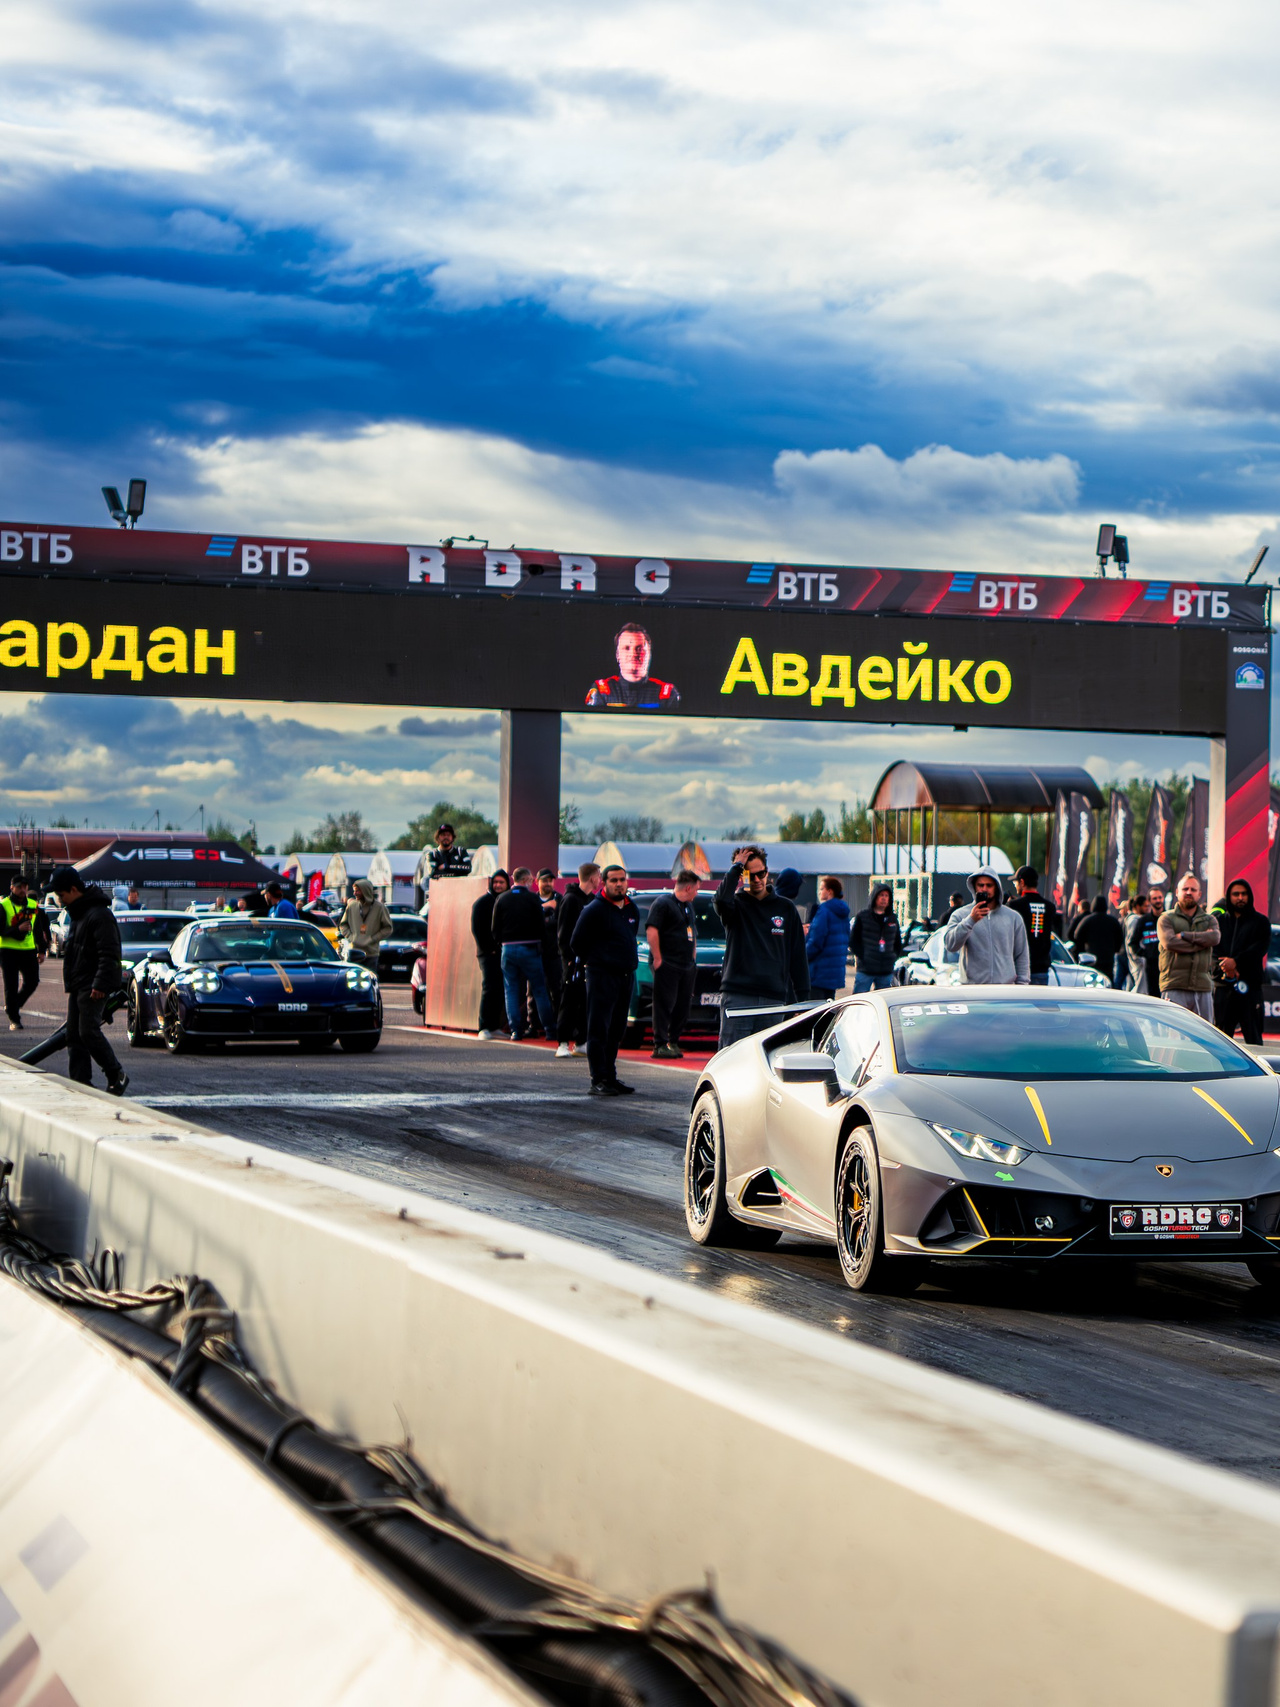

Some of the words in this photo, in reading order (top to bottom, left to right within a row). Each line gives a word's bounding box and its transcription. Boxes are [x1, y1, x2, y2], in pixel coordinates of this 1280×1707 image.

[0, 530, 73, 564] ВТБ
[241, 544, 310, 577] ВТБ
[777, 571, 839, 602] ВТБ
[978, 580, 1039, 611] ВТБ
[1172, 589, 1231, 619] ВТБ
[720, 637, 1013, 708] Авдейко
[900, 1003, 970, 1017] 919
[1141, 1207, 1212, 1225] RDRC
